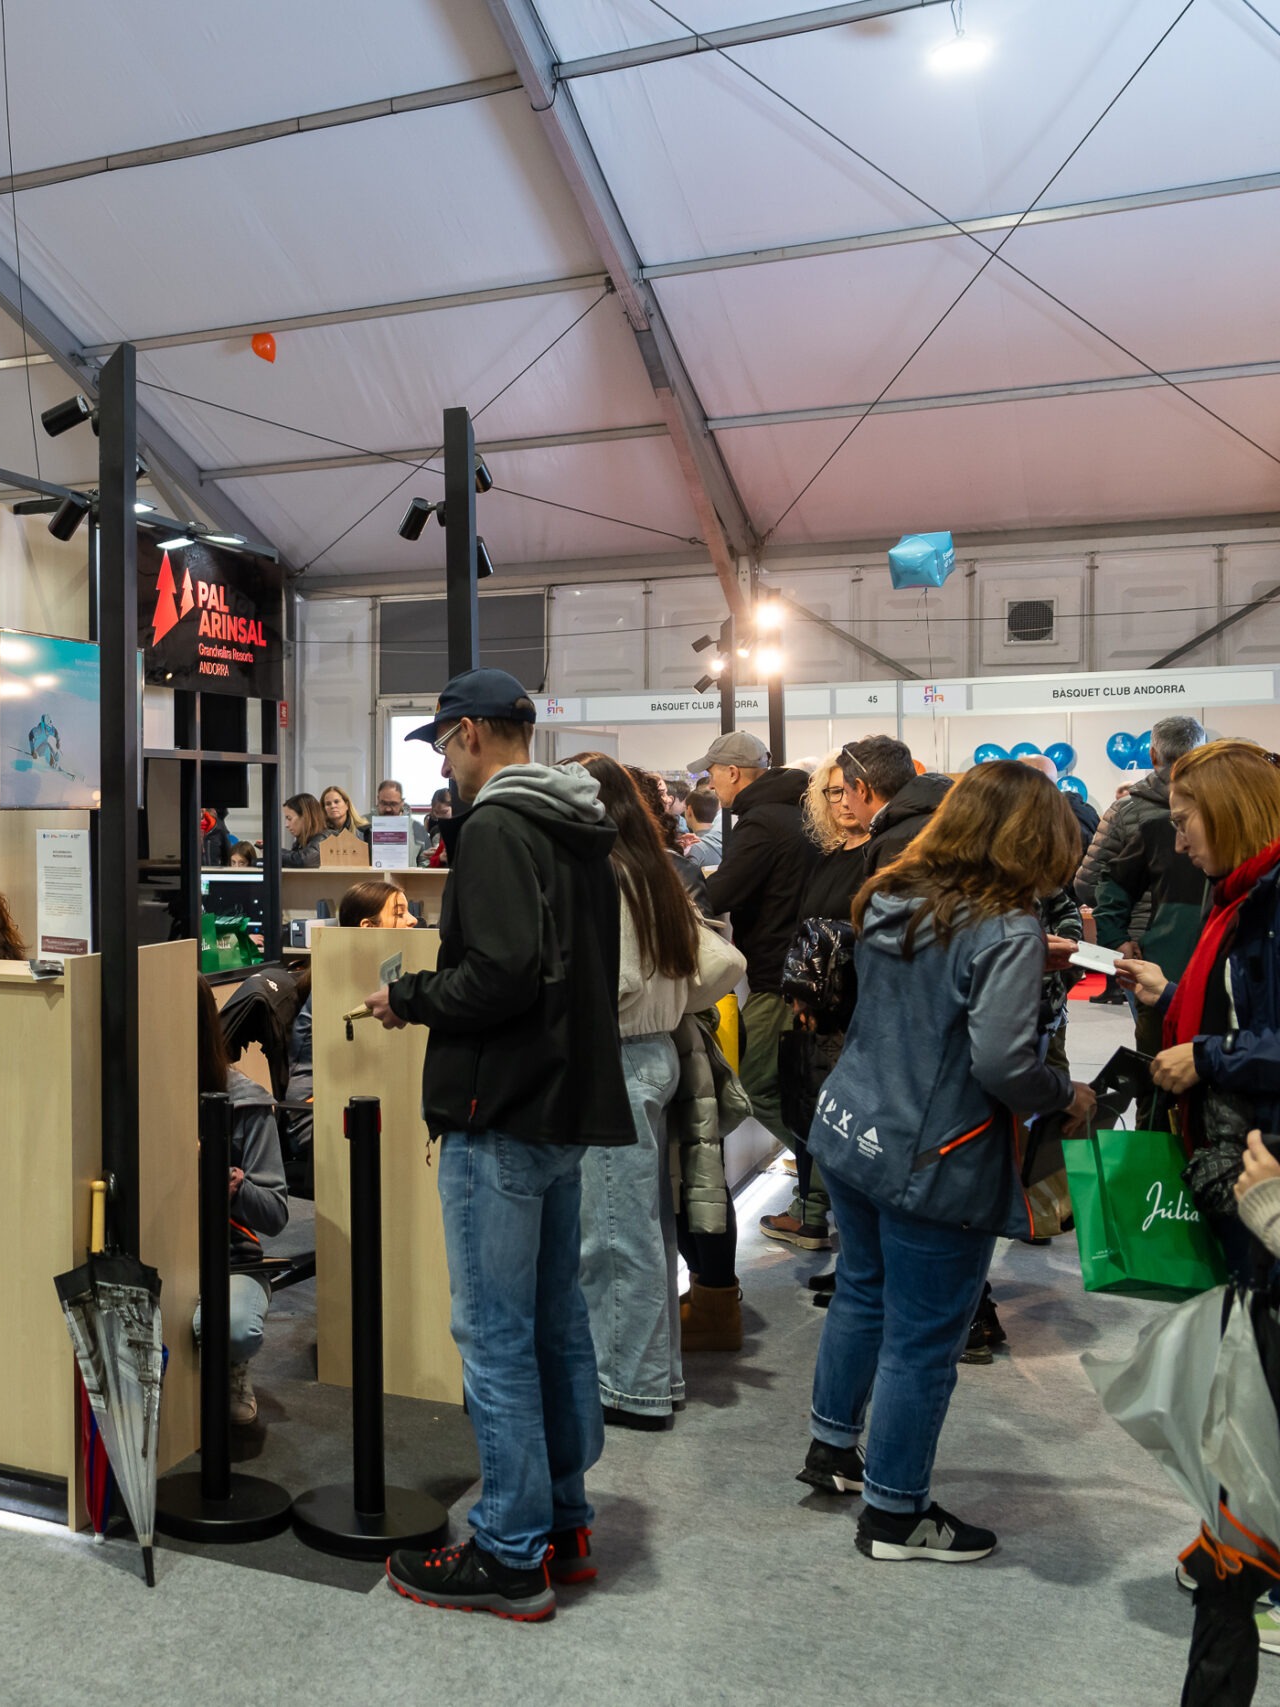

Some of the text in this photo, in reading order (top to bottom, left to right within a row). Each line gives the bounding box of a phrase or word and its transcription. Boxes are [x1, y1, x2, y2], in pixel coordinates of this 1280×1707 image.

[197, 580, 230, 613] PAL
[198, 609, 267, 647] ARINSAL
[198, 642, 254, 663] Grandvalira Resorts
[199, 660, 230, 677] ANDORRA
[867, 695, 878, 704] 45
[1052, 684, 1186, 698] BÀSQUET CLUB ANDORRA
[650, 700, 759, 711] BÀSQUET CLUB AORRA
[1142, 1181, 1200, 1232] Júlia
